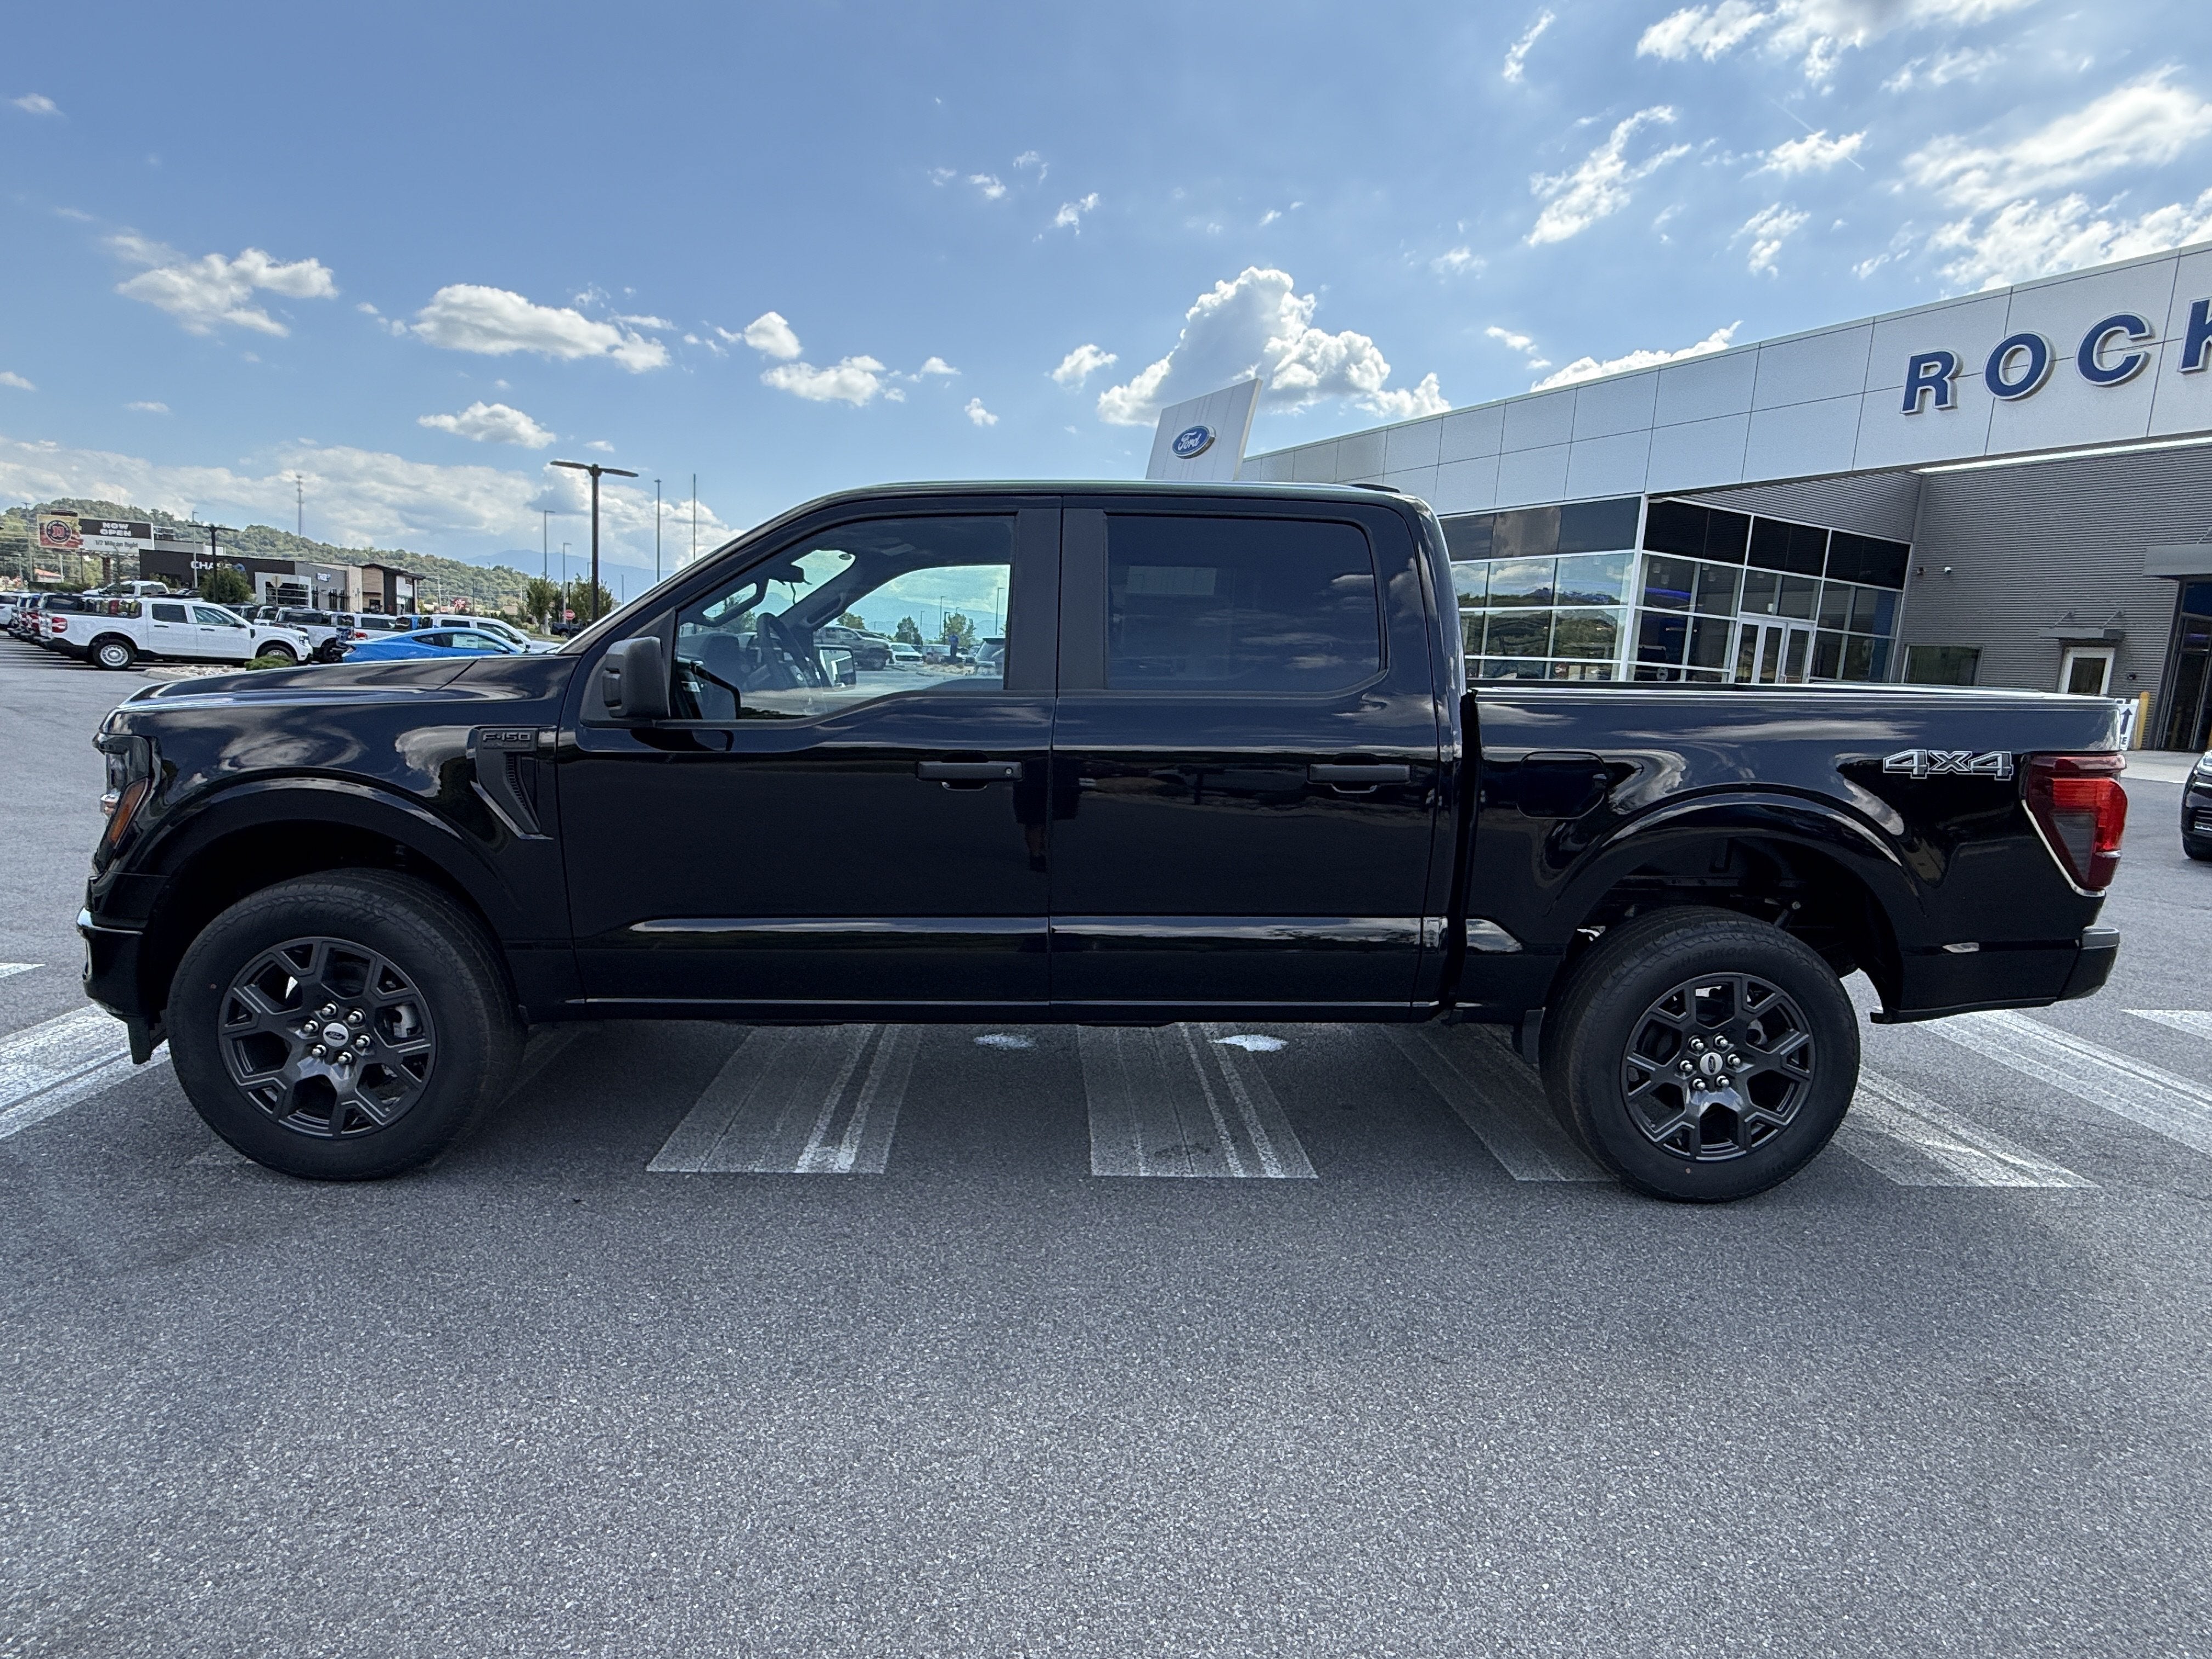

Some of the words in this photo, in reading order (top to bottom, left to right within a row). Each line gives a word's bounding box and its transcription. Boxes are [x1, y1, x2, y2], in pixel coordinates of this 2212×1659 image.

[1178, 431, 1202, 450] Ford
[100, 528, 132, 537] OPEN
[483, 732, 531, 741] F-150
